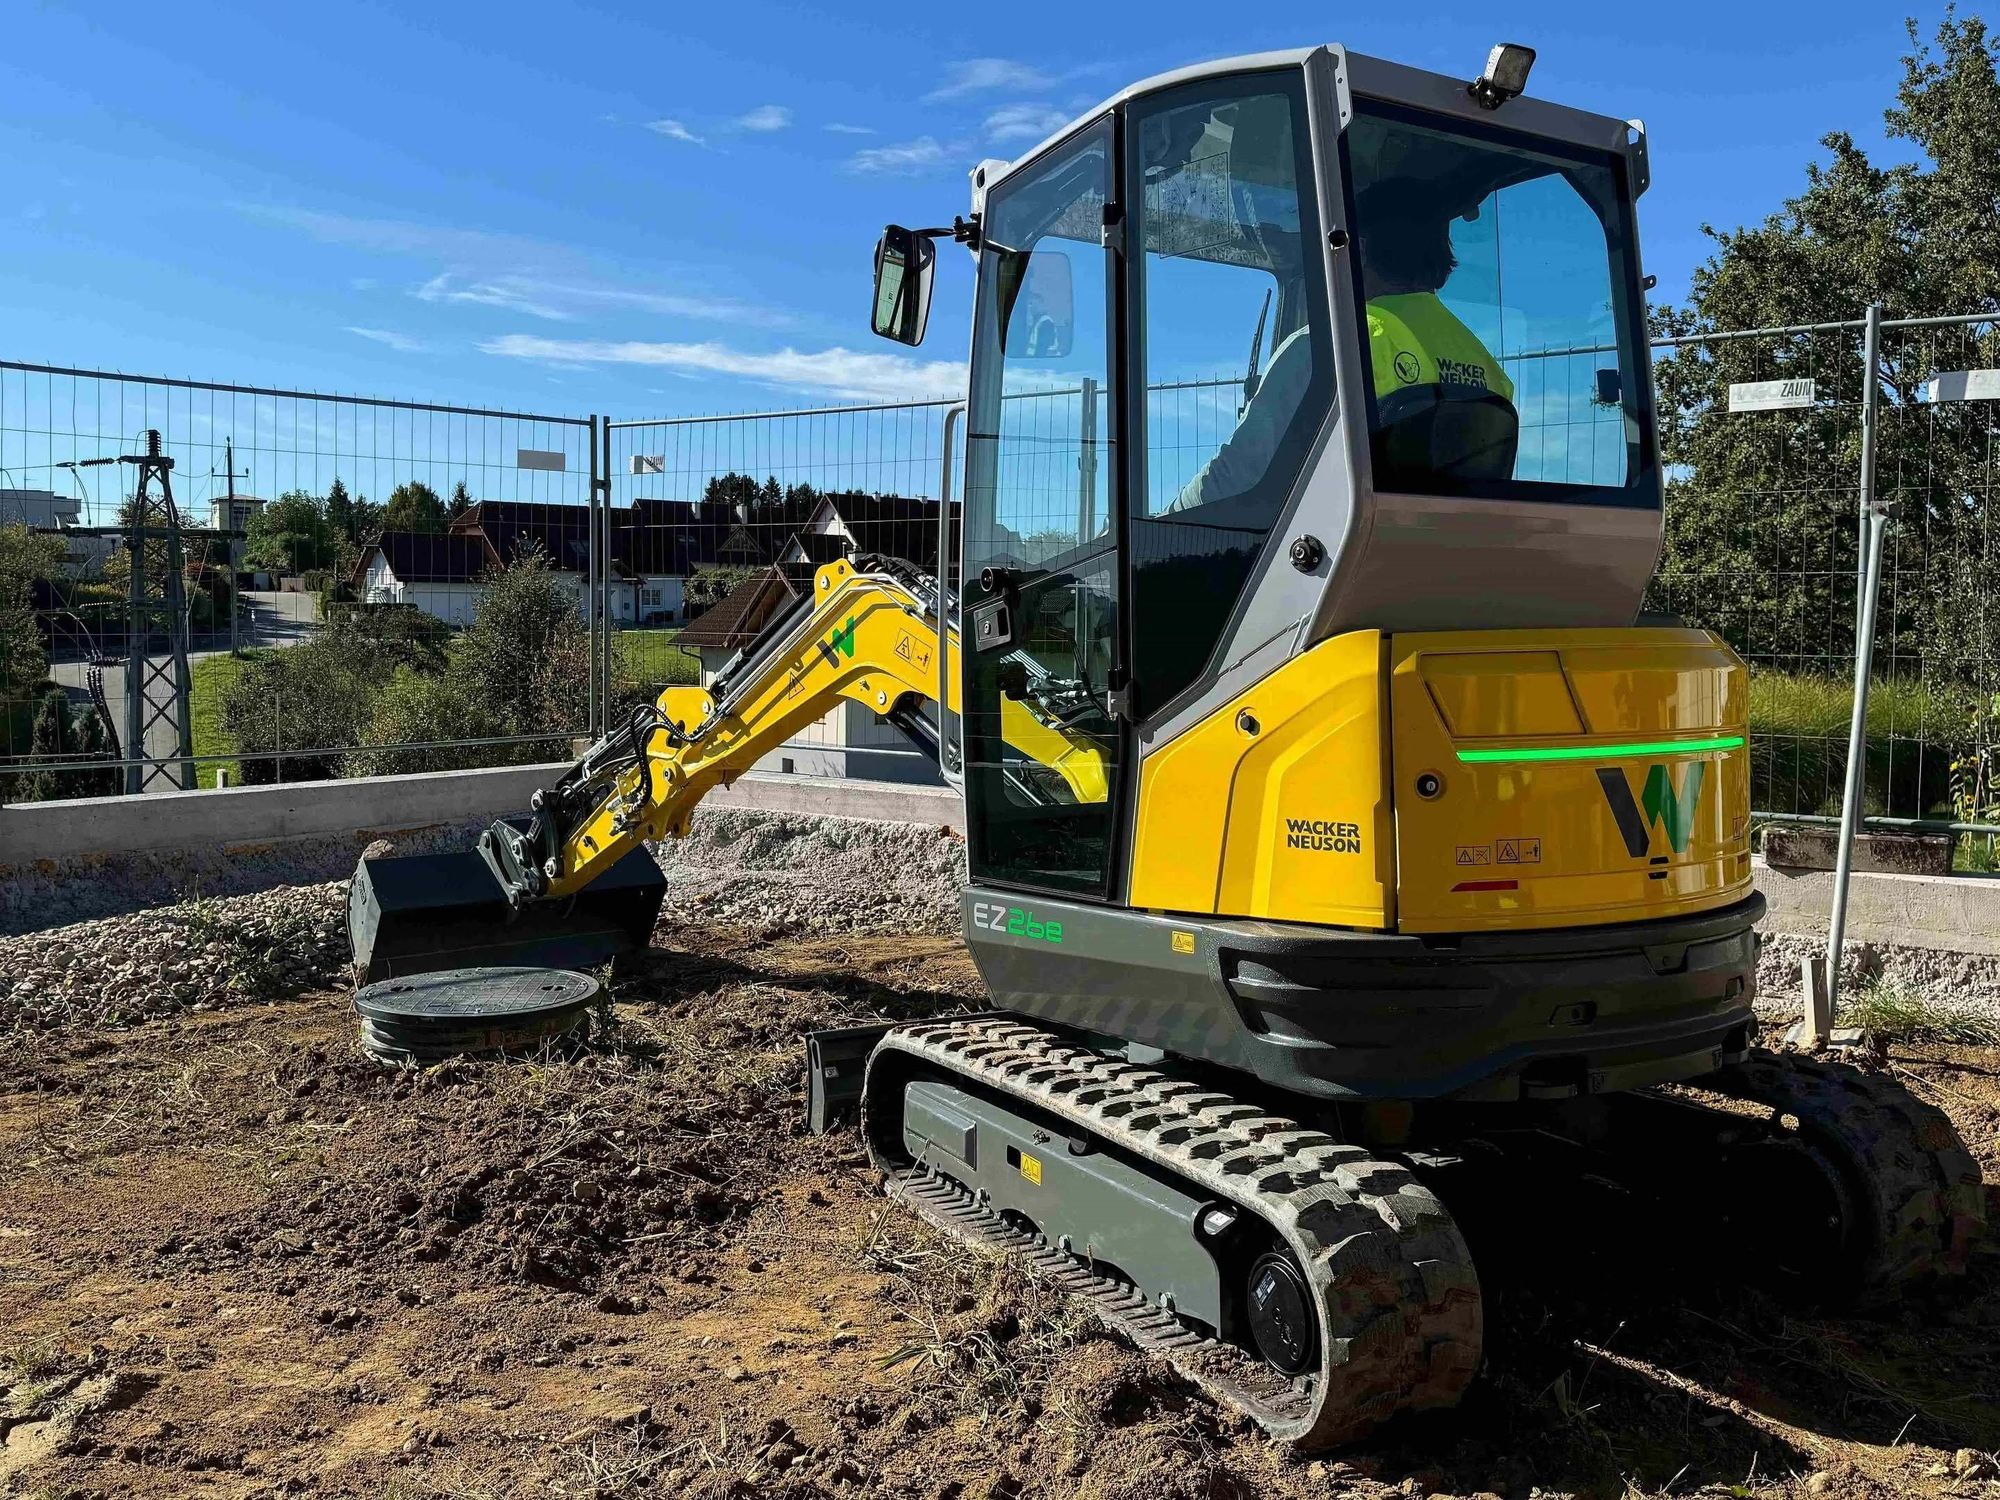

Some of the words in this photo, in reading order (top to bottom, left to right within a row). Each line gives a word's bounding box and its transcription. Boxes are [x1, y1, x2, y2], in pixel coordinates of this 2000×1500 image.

[1780, 381, 1811, 397] ZAUN
[1286, 819, 1360, 838] WACKER
[1287, 834, 1360, 853] NEUSON
[973, 902, 1063, 944] EZ26e
